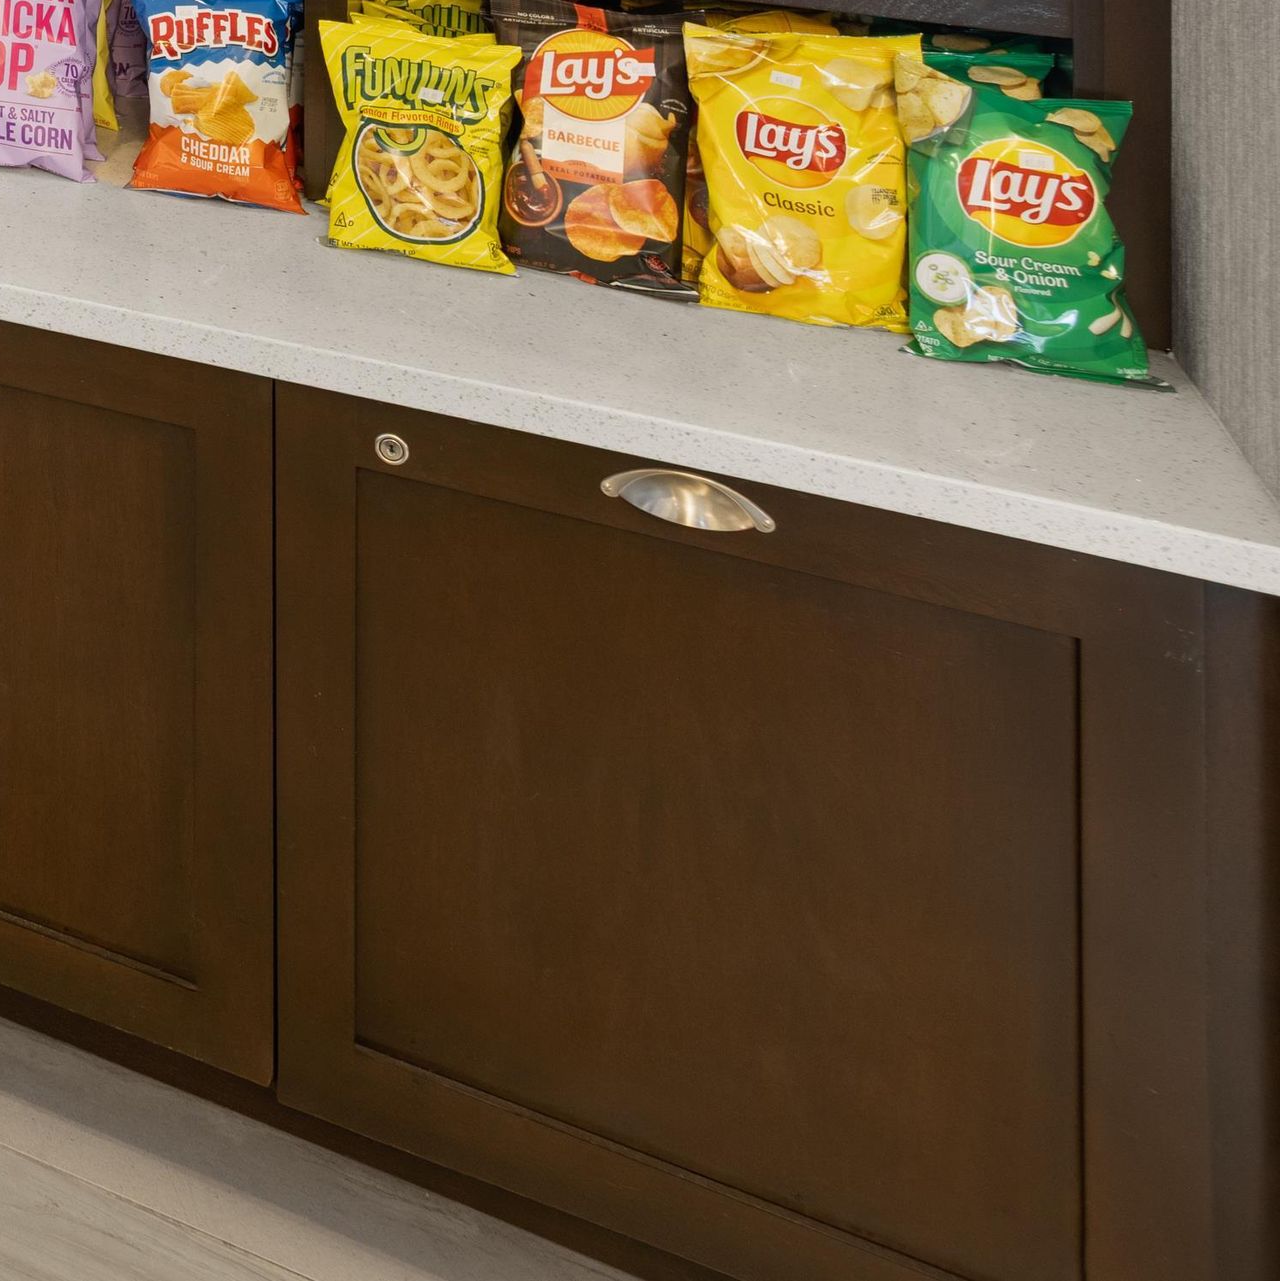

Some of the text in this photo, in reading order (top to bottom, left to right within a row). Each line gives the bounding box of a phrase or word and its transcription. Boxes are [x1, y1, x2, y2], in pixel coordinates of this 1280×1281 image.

[530, 12, 555, 20] COLORS
[150, 11, 279, 58] RUFFLES
[632, 27, 670, 35] ARTIFICIAL
[65, 63, 79, 79] 70
[540, 48, 640, 100] Lay's
[342, 45, 495, 123] FUNYUNS
[8, 106, 17, 120] &
[20, 107, 55, 125] SALTY
[391, 111, 434, 125] Flavored
[436, 116, 460, 133] Rings
[21, 125, 73, 151] CORN
[547, 129, 620, 152] BARBECUE
[744, 112, 840, 170] Lay's
[181, 136, 250, 165] CHEDDAR
[181, 153, 250, 177] & SOUR CREAM
[549, 165, 618, 184] REAL POTATOES
[967, 159, 1088, 224] Lay's
[763, 191, 835, 218] Classic
[975, 250, 1082, 277] Sour Cream
[995, 267, 1069, 288] & Onion
[1013, 286, 1052, 297] Flavored
